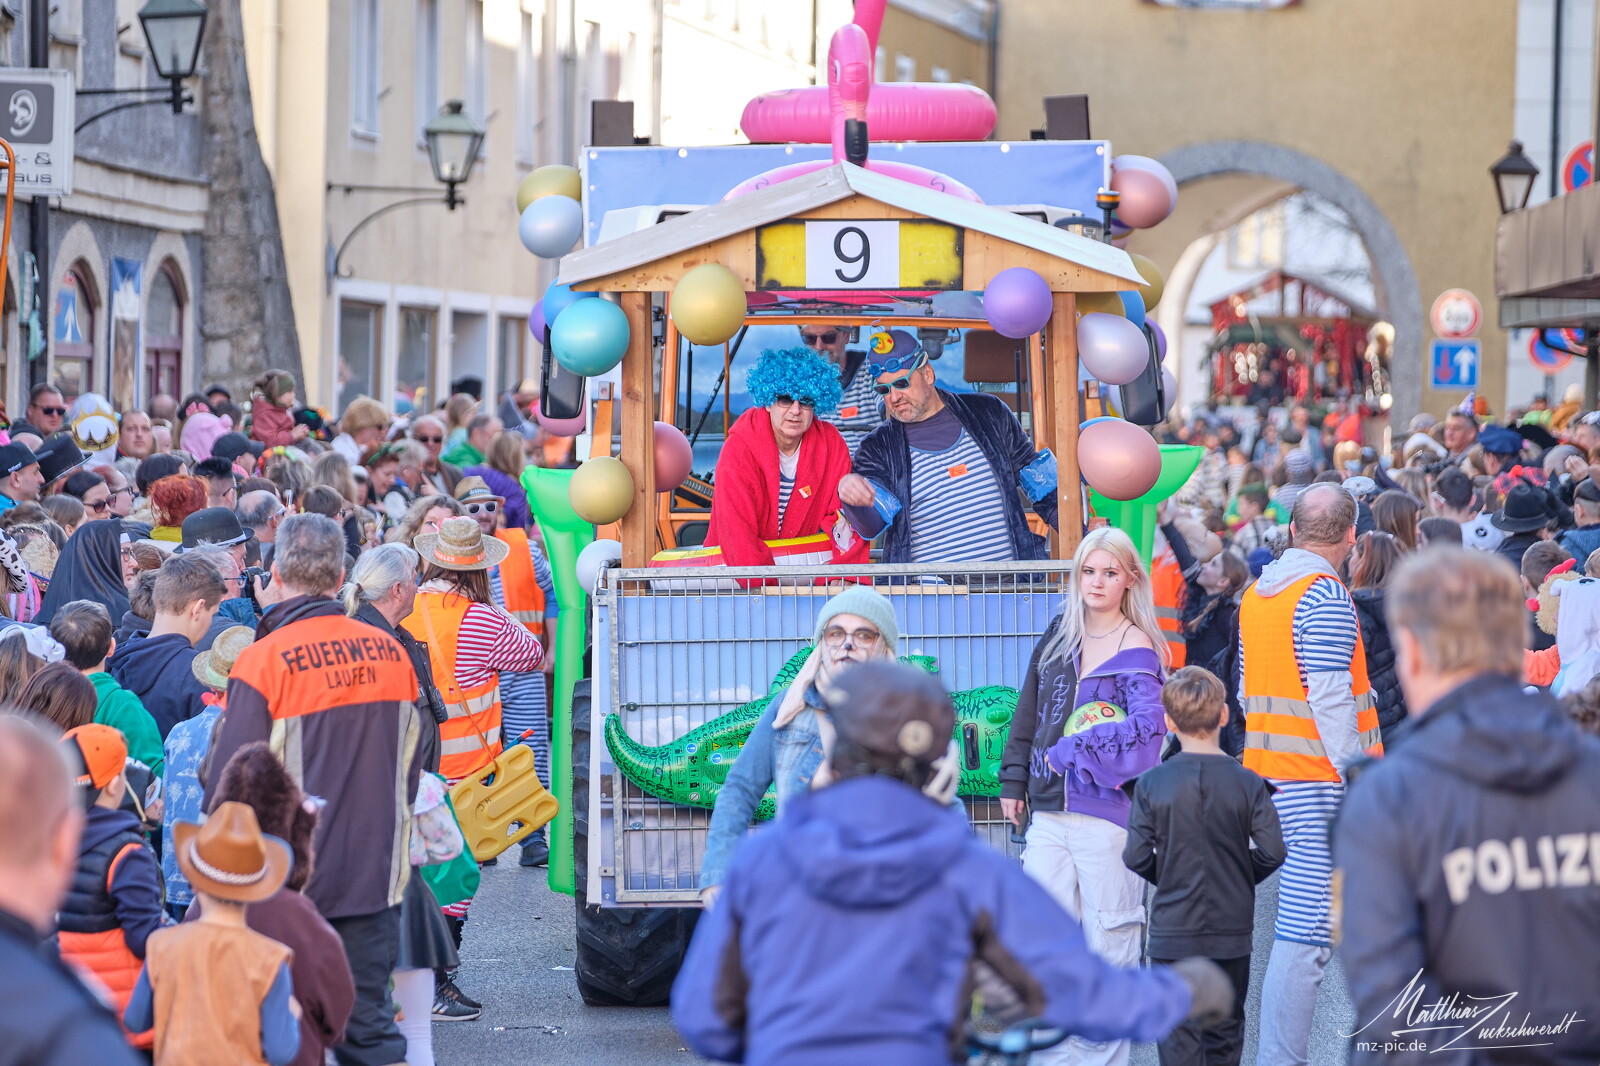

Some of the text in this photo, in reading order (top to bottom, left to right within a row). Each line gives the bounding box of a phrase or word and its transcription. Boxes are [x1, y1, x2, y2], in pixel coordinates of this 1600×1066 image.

[833, 226, 870, 283] 9
[281, 637, 401, 675] FEUERWEHR
[325, 665, 376, 689] LAUFEN
